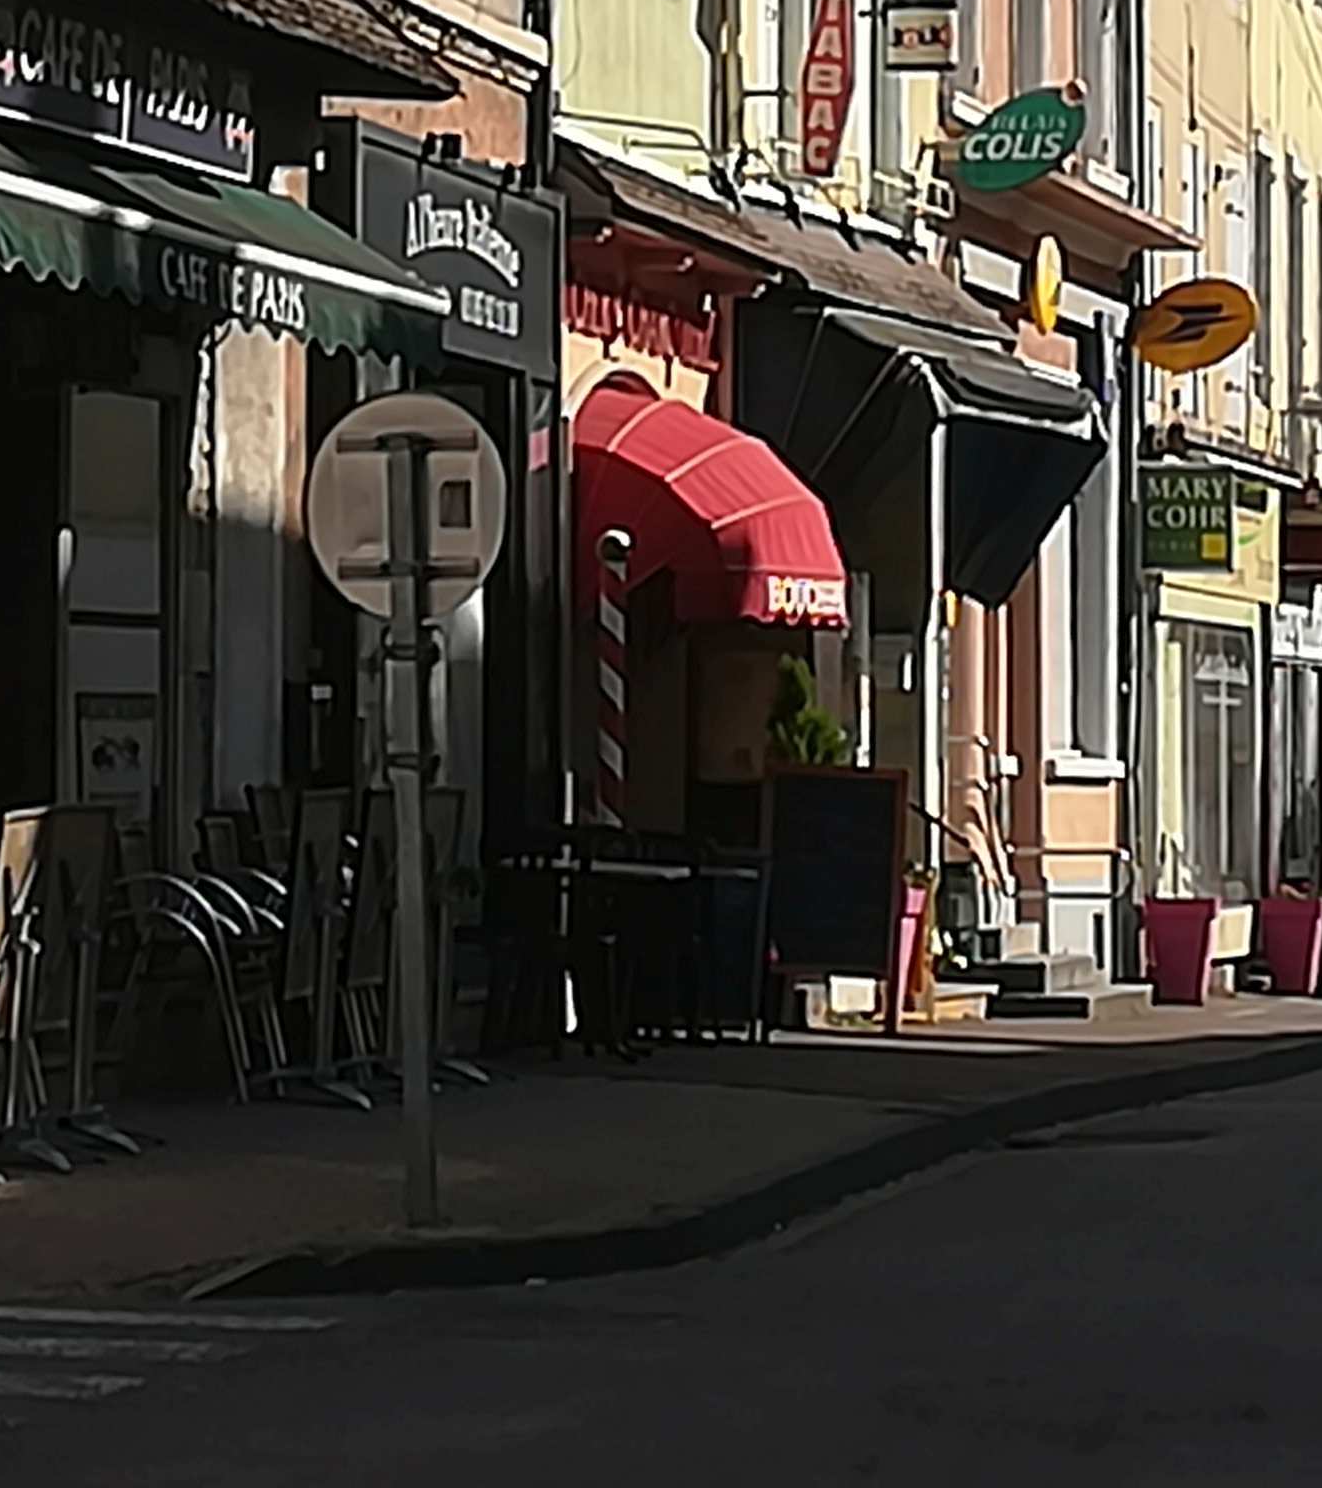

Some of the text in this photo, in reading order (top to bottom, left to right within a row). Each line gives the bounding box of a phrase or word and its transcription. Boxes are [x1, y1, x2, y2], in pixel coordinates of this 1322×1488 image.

[964, 132, 1064, 160] COLIS
[250, 271, 304, 330] PARIS
[1147, 476, 1227, 500] MARY
